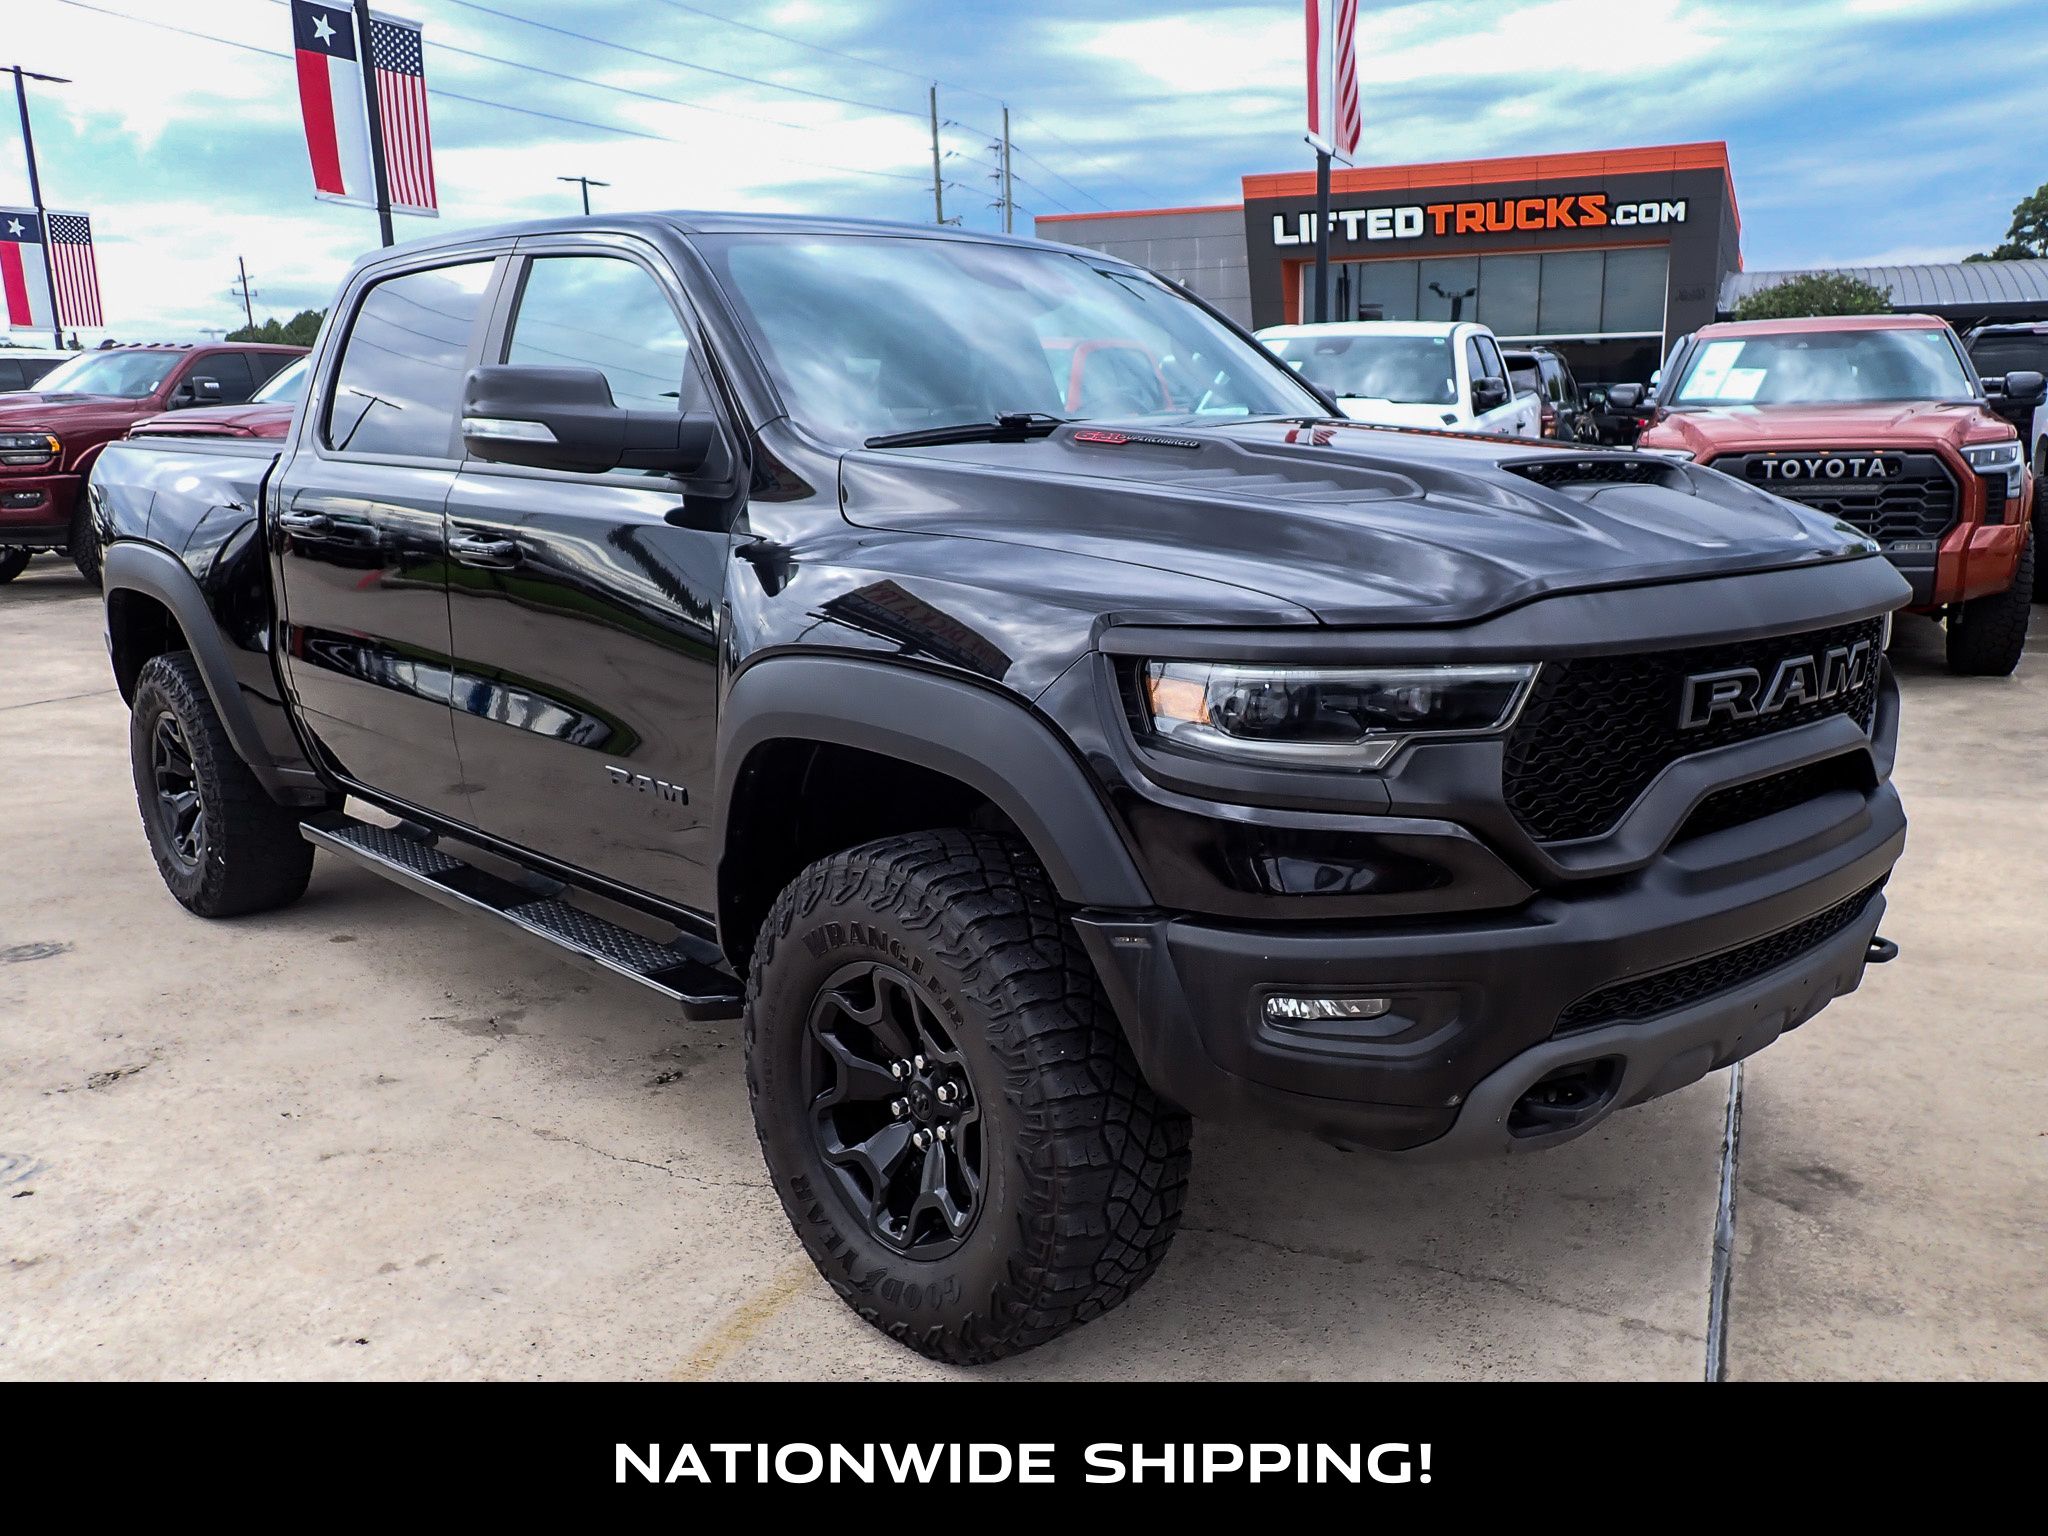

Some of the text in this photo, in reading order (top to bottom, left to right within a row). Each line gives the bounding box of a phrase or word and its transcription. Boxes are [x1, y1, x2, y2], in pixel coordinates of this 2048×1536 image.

[1762, 458, 1886, 479] TOYOTA
[1679, 640, 1871, 729] RAM
[605, 765, 690, 806] RAM
[801, 920, 964, 1030] WRANGLER
